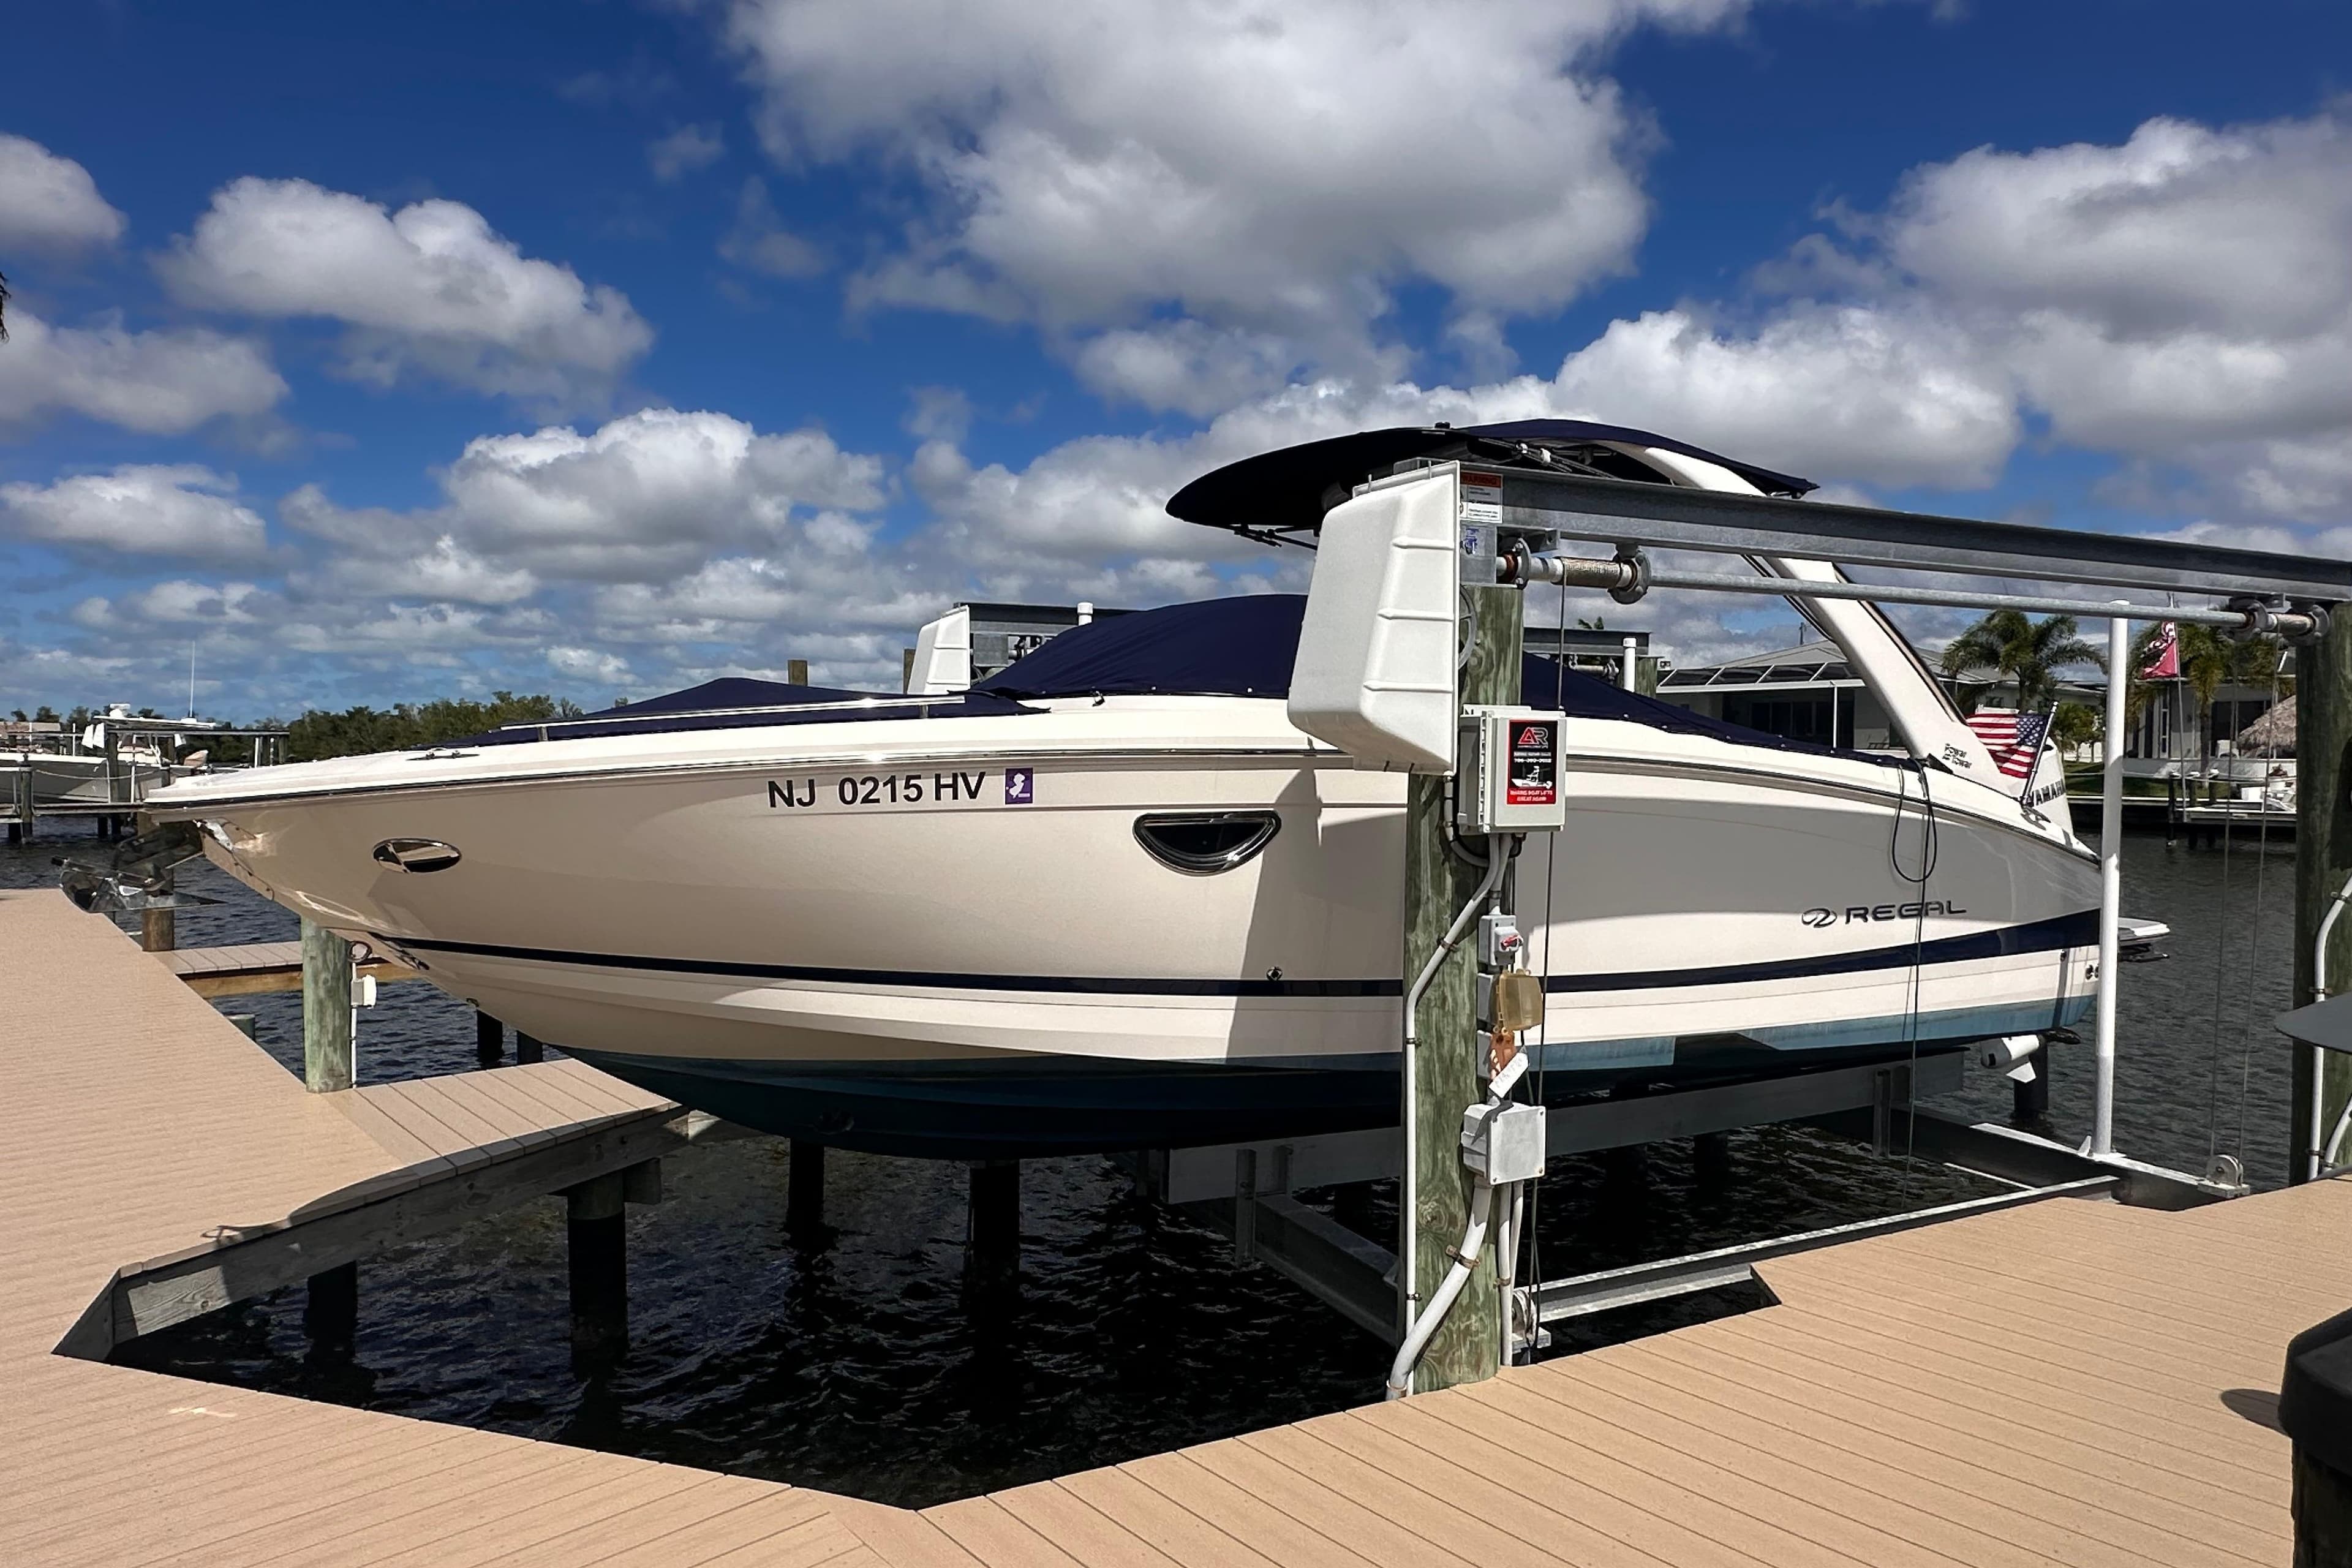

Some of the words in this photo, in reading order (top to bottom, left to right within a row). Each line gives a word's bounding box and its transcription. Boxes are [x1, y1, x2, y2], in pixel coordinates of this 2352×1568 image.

[767, 778, 815, 809] NJ
[838, 774, 923, 805] 0215
[934, 771, 986, 802] HV
[1845, 900, 1967, 925] REGAL
